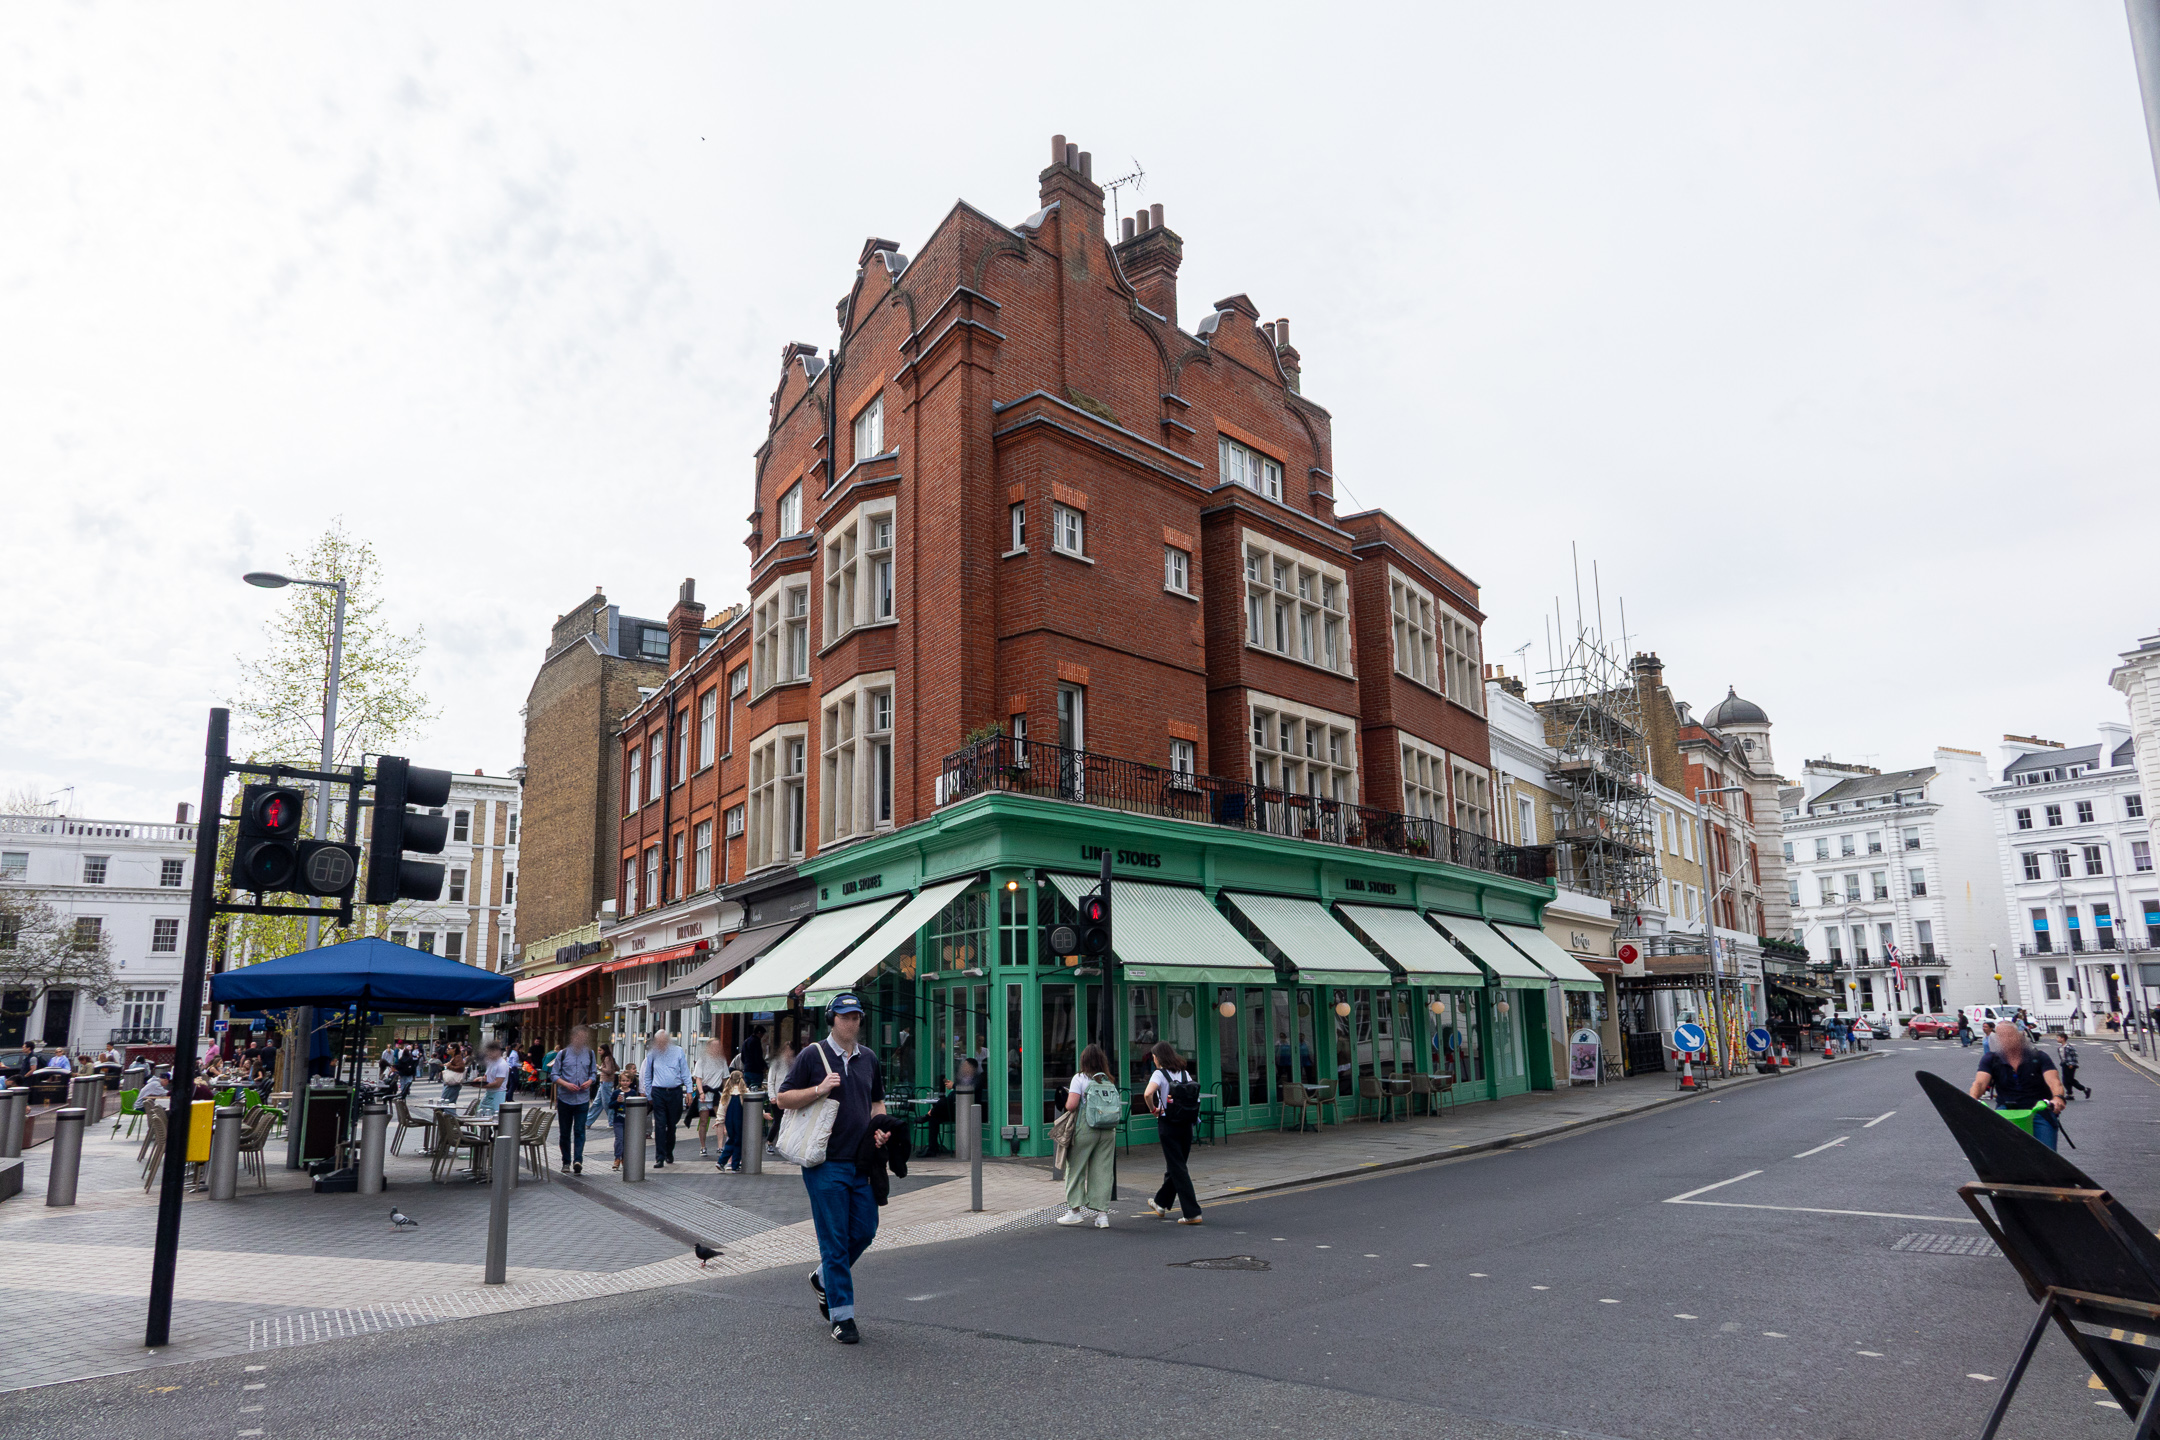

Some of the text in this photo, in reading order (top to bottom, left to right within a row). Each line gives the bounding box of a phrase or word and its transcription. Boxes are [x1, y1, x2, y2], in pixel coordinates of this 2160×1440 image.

[1081, 845, 1162, 868] LIN STORES
[842, 881, 857, 896] LINA
[858, 874, 882, 892] STORES
[1345, 879, 1397, 895] LINA STORES
[631, 922, 703, 951] TAPAS BRINDISA
